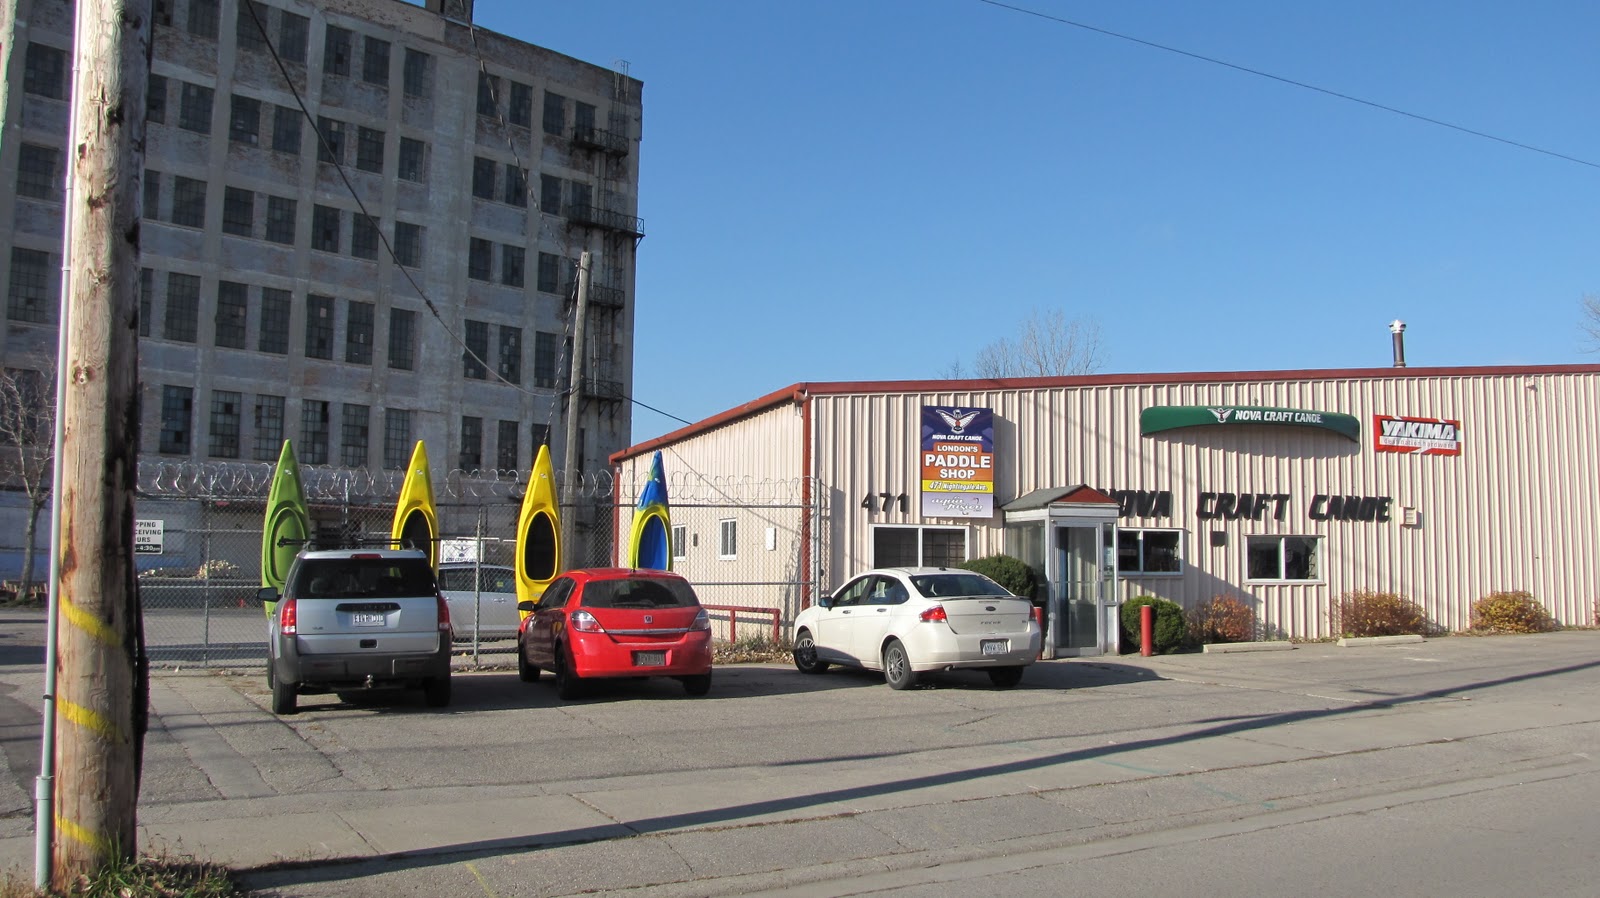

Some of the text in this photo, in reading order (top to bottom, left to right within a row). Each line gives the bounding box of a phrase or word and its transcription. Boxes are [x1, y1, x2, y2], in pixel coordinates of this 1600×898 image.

[1235, 410, 1321, 423] NOVA CRAFT CANOE
[1382, 420, 1455, 440] YAKIMA
[937, 445, 978, 453] LONDON'S
[925, 454, 991, 468] PADDLE
[940, 468, 975, 479] SHOP
[929, 482, 942, 490] 471
[942, 483, 975, 491] Nightingale
[861, 493, 909, 513] 471
[1196, 491, 1291, 520] CRAFT
[1308, 494, 1394, 522] CANOE
